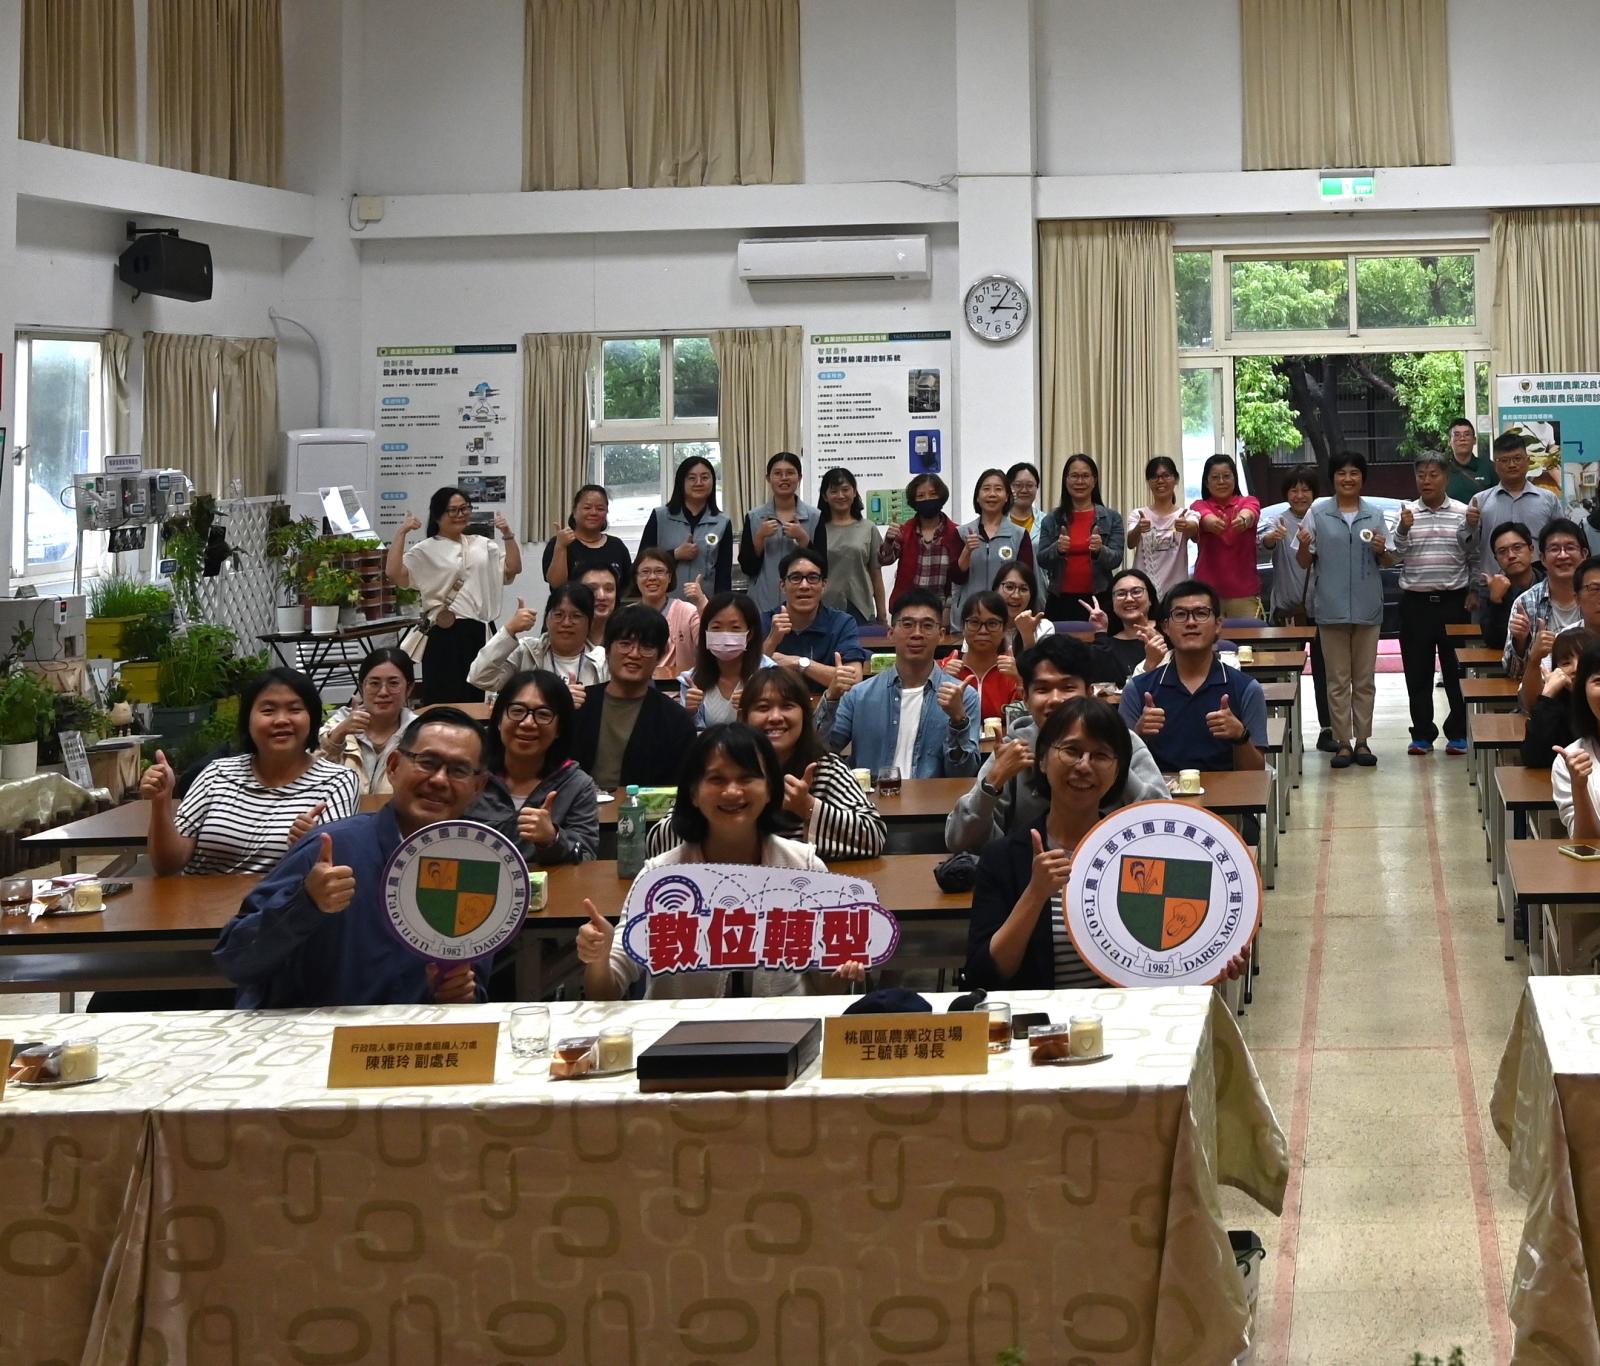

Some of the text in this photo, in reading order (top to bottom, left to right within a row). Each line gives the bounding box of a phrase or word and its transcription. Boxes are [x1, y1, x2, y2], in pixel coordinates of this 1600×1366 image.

[982, 286, 990, 295] 11
[991, 282, 1000, 291] 12
[975, 294, 985, 303] 10
[1011, 292, 1018, 300] 2
[972, 305, 979, 314] 9
[1015, 302, 1022, 311] 3
[976, 315, 983, 324] 8
[1012, 312, 1018, 320] 4
[985, 322, 991, 331] 7
[994, 324, 1001, 333] 6
[1004, 321, 1011, 330] 5
[1085, 895, 1133, 968] Taoyuan
[1220, 907, 1241, 942] MOA
[648, 907, 872, 972] 數位轉型
[442, 947, 462, 957] 1982
[1146, 962, 1170, 973] 1982
[844, 1026, 963, 1045] 桃園區農業改良場
[861, 1043, 945, 1061] 王毓華 場長
[365, 1052, 459, 1070] 陳雅玲 副處長
